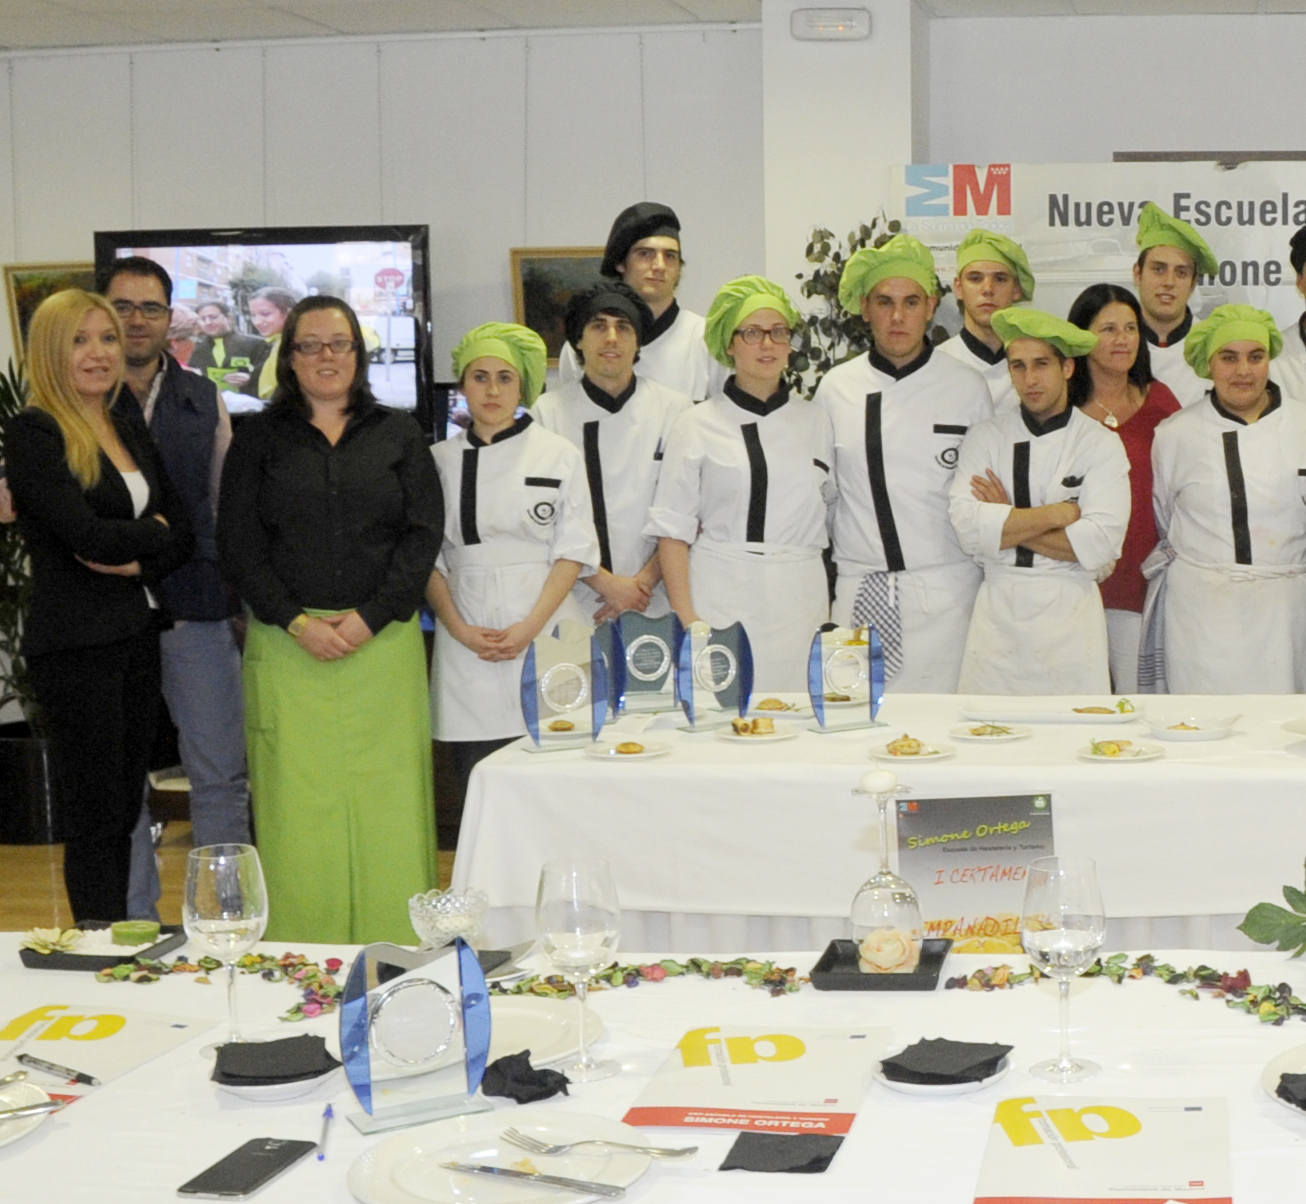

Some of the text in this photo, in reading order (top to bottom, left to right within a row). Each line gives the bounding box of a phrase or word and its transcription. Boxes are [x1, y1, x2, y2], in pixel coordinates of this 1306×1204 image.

[375, 274, 403, 283] STOP
[907, 820, 1032, 850] Simone Ortega
[934, 869, 945, 885] I
[677, 1026, 806, 1068] fp
[684, 1116, 750, 1126] SIMONE
[754, 1118, 827, 1130] ORTEGA
[993, 1096, 1142, 1147] fp
